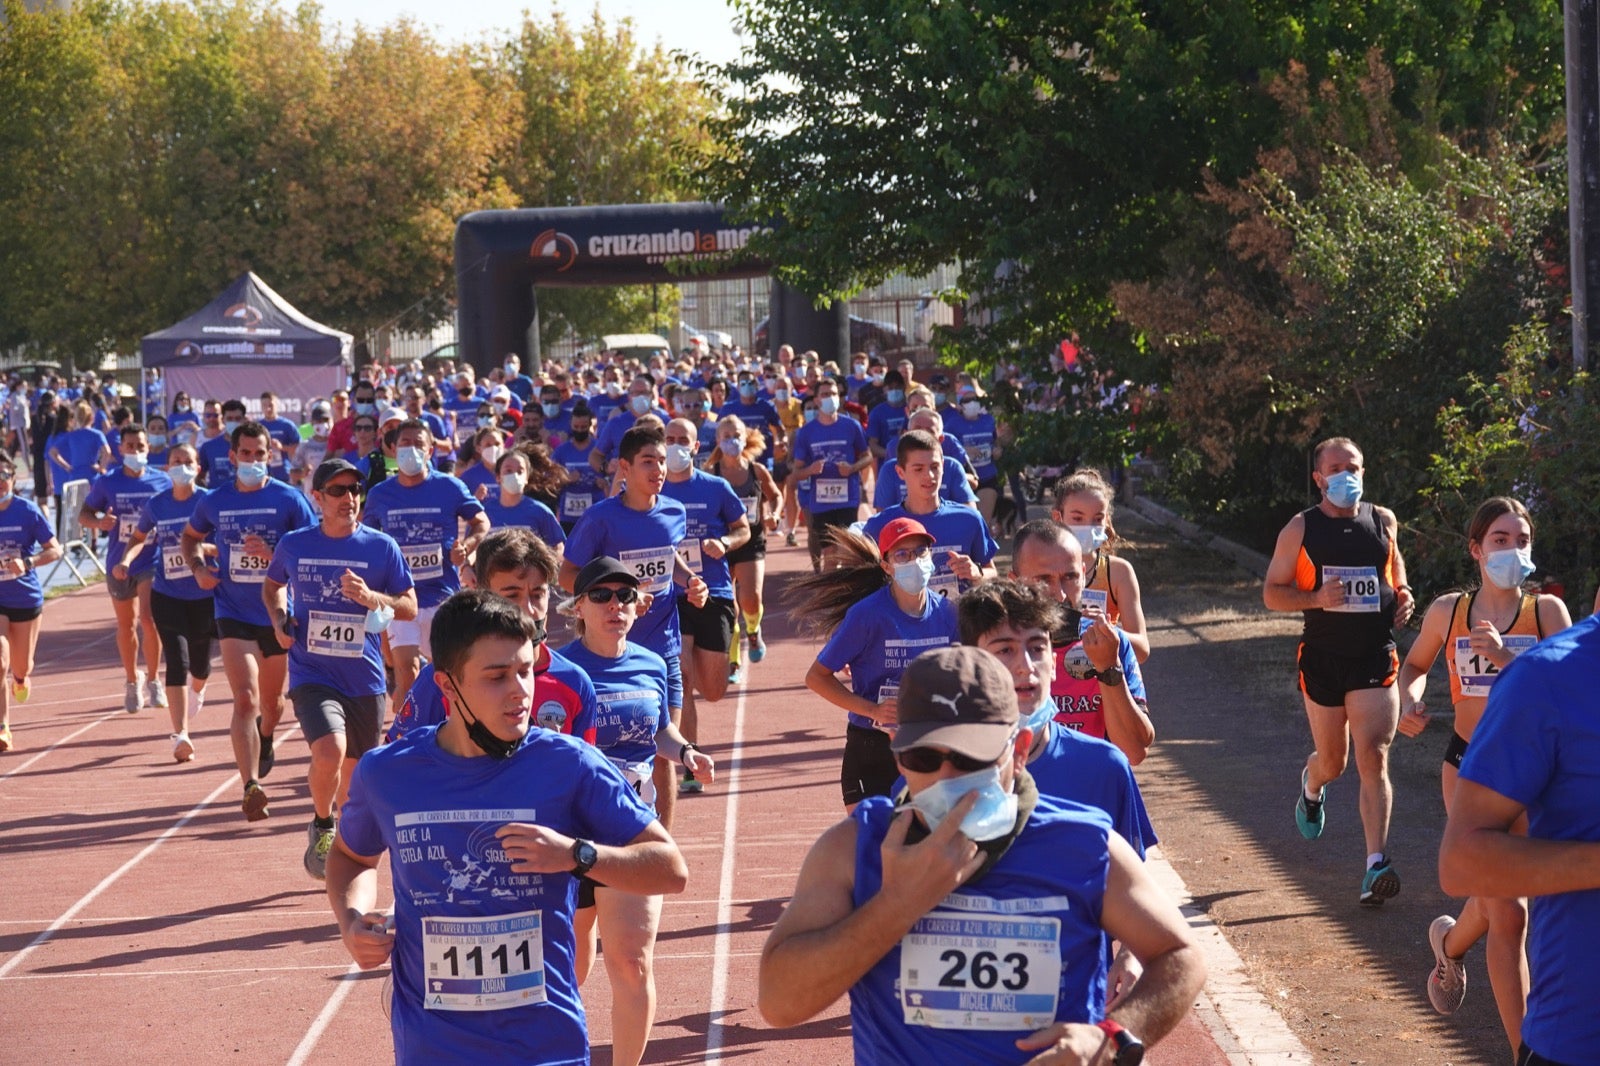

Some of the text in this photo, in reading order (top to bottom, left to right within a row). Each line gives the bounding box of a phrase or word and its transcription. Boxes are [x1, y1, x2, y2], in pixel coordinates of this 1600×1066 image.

[588, 226, 774, 257] cruzandolame
[824, 486, 842, 495] 157
[240, 556, 269, 569] 539
[635, 560, 666, 578] 365
[320, 625, 355, 642] 410
[426, 812, 451, 821] CARRERA
[453, 811, 466, 821] AZUL
[469, 811, 480, 820] POR
[481, 811, 489, 820] EL
[491, 810, 516, 820] AUTISMO
[396, 827, 431, 844] VUELVE LA
[427, 845, 448, 861] AZUL
[431, 917, 534, 933] VI CARRERA AZUL POR EL AUTISMO
[926, 919, 961, 933] CARRERA
[964, 921, 984, 934] AZUL
[987, 922, 1004, 935] POR
[1006, 923, 1015, 936] EL
[1019, 923, 1051, 937] AUTISMO
[443, 939, 530, 976] 1111
[938, 949, 1029, 991] 263
[959, 993, 988, 1011] MIGUEL
